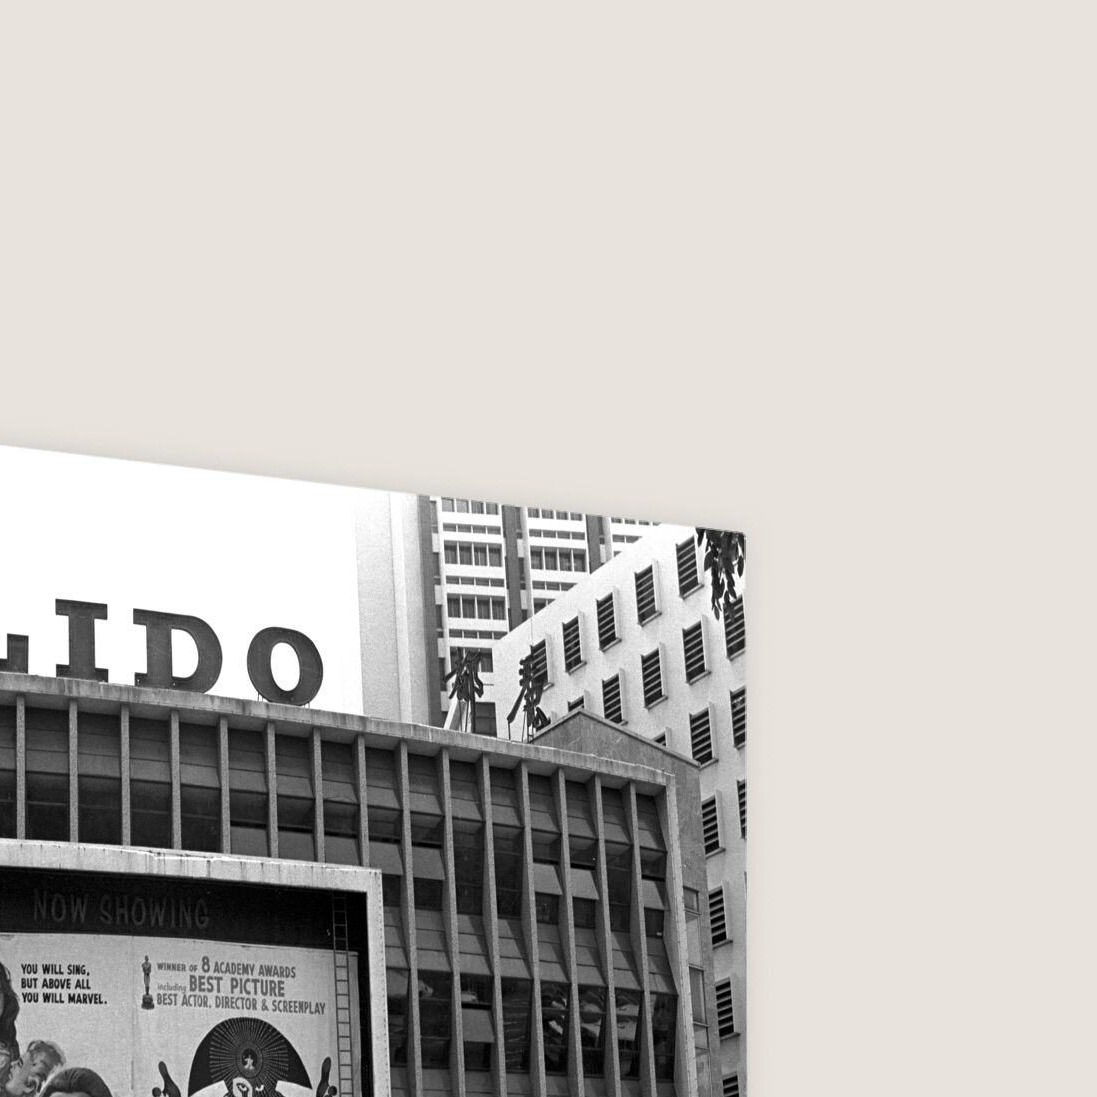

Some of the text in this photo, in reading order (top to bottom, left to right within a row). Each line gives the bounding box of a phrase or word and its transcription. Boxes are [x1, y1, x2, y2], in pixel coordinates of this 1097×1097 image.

[33, 889, 209, 929] NOW SHOWING
[21, 963, 90, 976] YOU WILL SING,
[157, 955, 296, 979] WINNER OF 8 ACADEMY AWARDS
[21, 978, 91, 990] BUT ABOVE ALL
[157, 975, 285, 997] including BEST PICTURE
[22, 992, 108, 1005] YOU WILL MARVEL.
[157, 993, 178, 1006] BEST
[215, 996, 257, 1011] DIRECTOR
[261, 999, 269, 1011] &
[272, 1000, 326, 1015] SCREENPLAY
